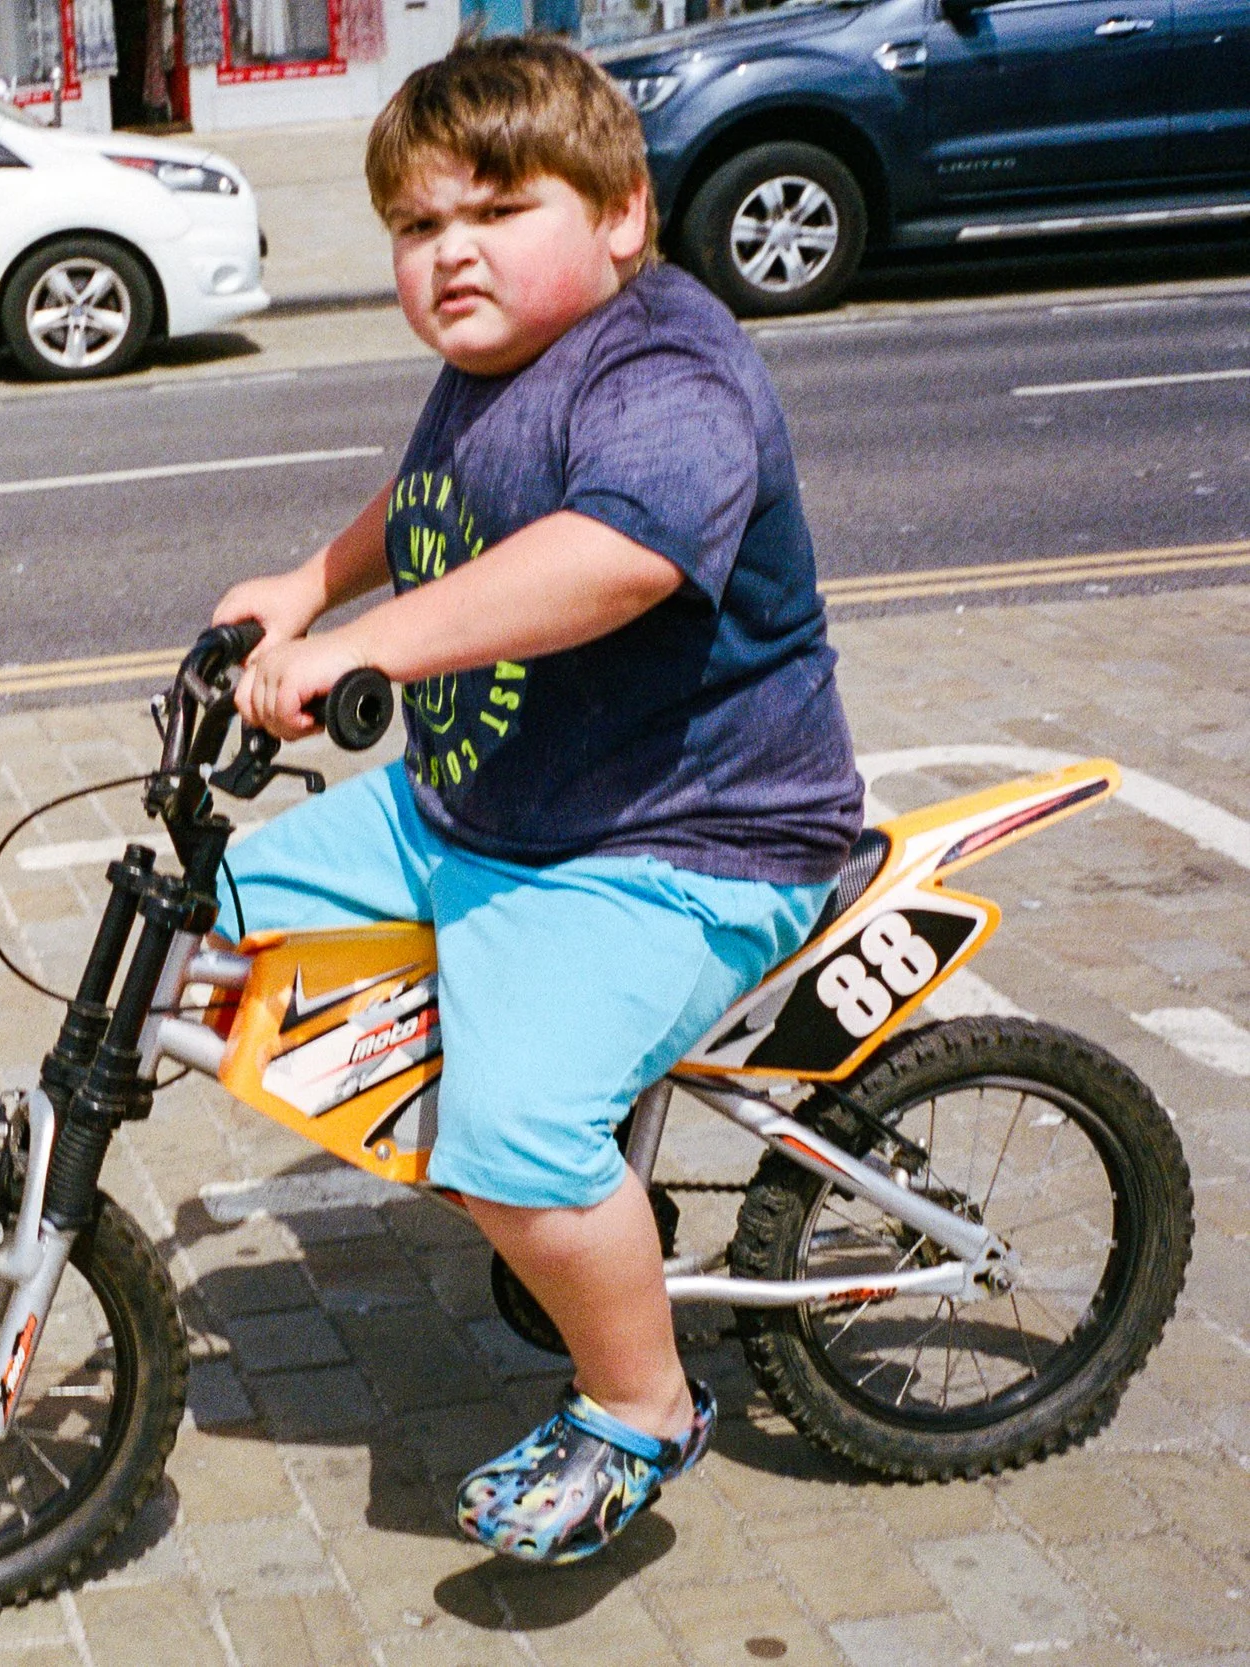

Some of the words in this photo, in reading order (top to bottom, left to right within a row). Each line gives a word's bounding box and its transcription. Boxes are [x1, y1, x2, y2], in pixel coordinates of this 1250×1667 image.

[937, 157, 1017, 174] LIMITED
[410, 524, 447, 578] NYC
[816, 911, 939, 1039] 88
